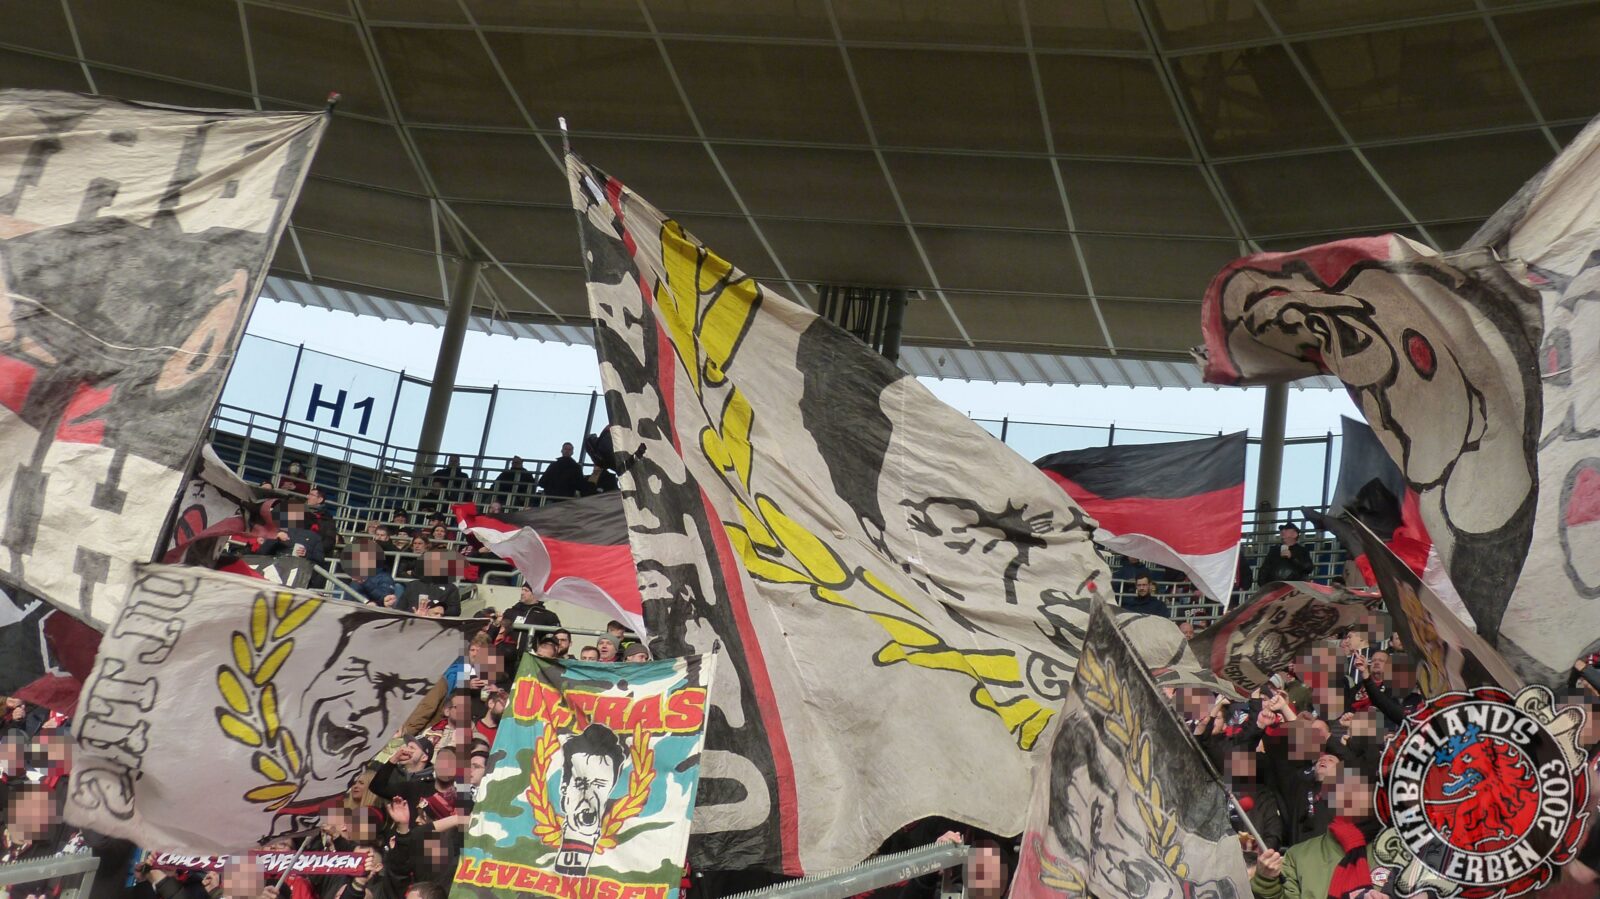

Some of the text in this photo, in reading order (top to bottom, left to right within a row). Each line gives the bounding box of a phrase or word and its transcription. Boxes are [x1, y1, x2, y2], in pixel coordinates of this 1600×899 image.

[306, 383, 375, 435] H1
[513, 678, 706, 732] ULTRAS
[257, 853, 362, 872] EVERKUSEN
[456, 857, 669, 899] LEVERKUSEN
[563, 852, 582, 866] UL
